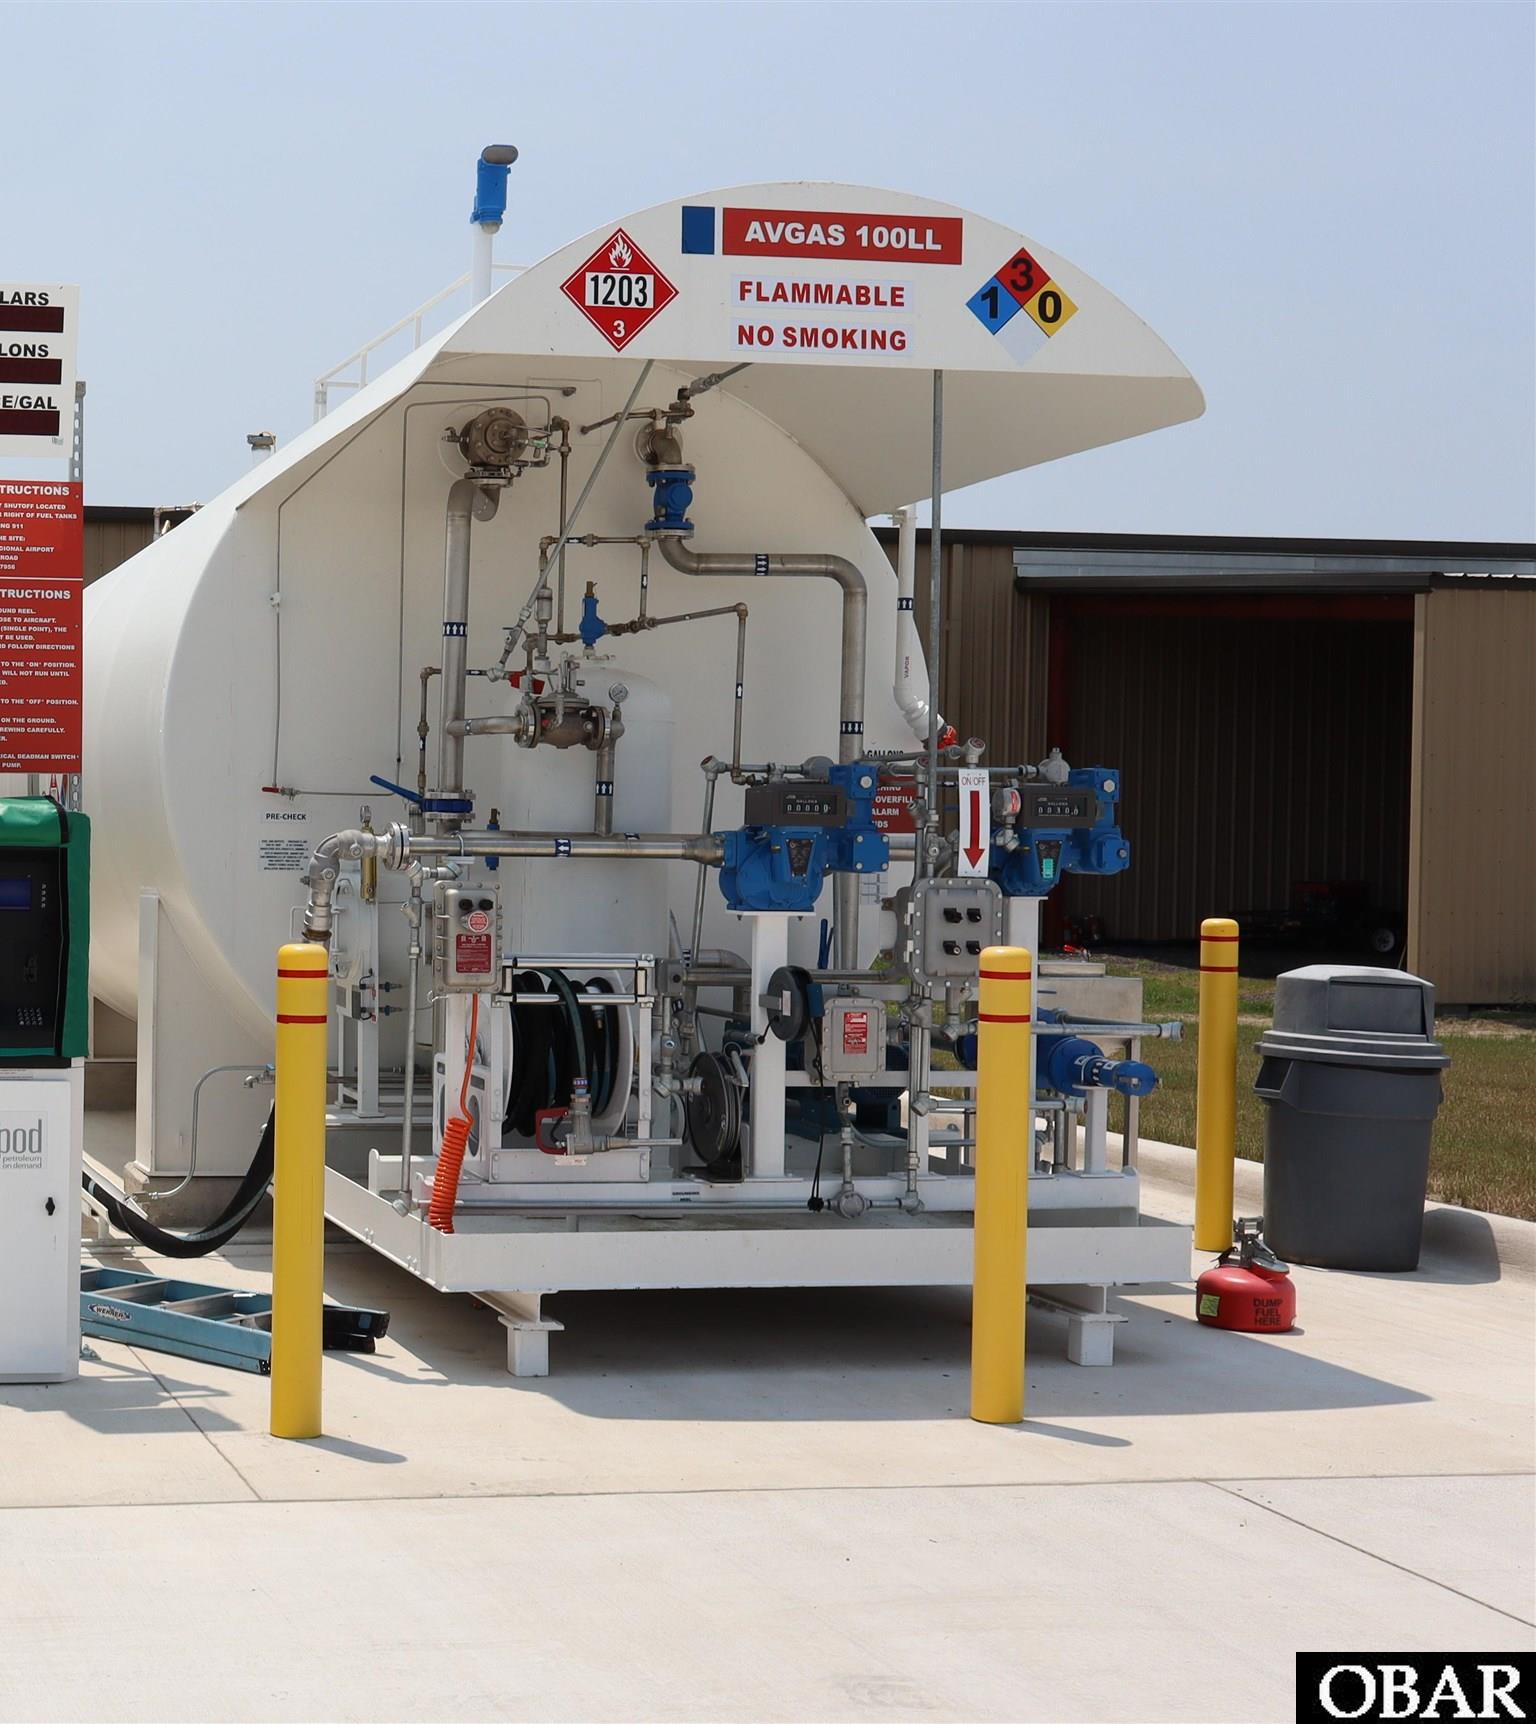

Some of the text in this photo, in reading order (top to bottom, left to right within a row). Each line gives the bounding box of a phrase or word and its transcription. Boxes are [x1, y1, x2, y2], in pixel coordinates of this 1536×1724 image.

[745, 221, 942, 250] AVGAS 100LL
[1010, 257, 1034, 292] 3
[590, 274, 648, 307] 1203
[739, 281, 905, 307] FLAMMABLE
[980, 286, 999, 319] 1
[1038, 290, 1062, 323] 0
[613, 320, 625, 338] 3
[738, 325, 906, 351] NO SMOKING
[875, 795, 914, 804] OVERFILL
[3, 1155, 42, 1165] petroleum
[13, 1161, 42, 1169] demand
